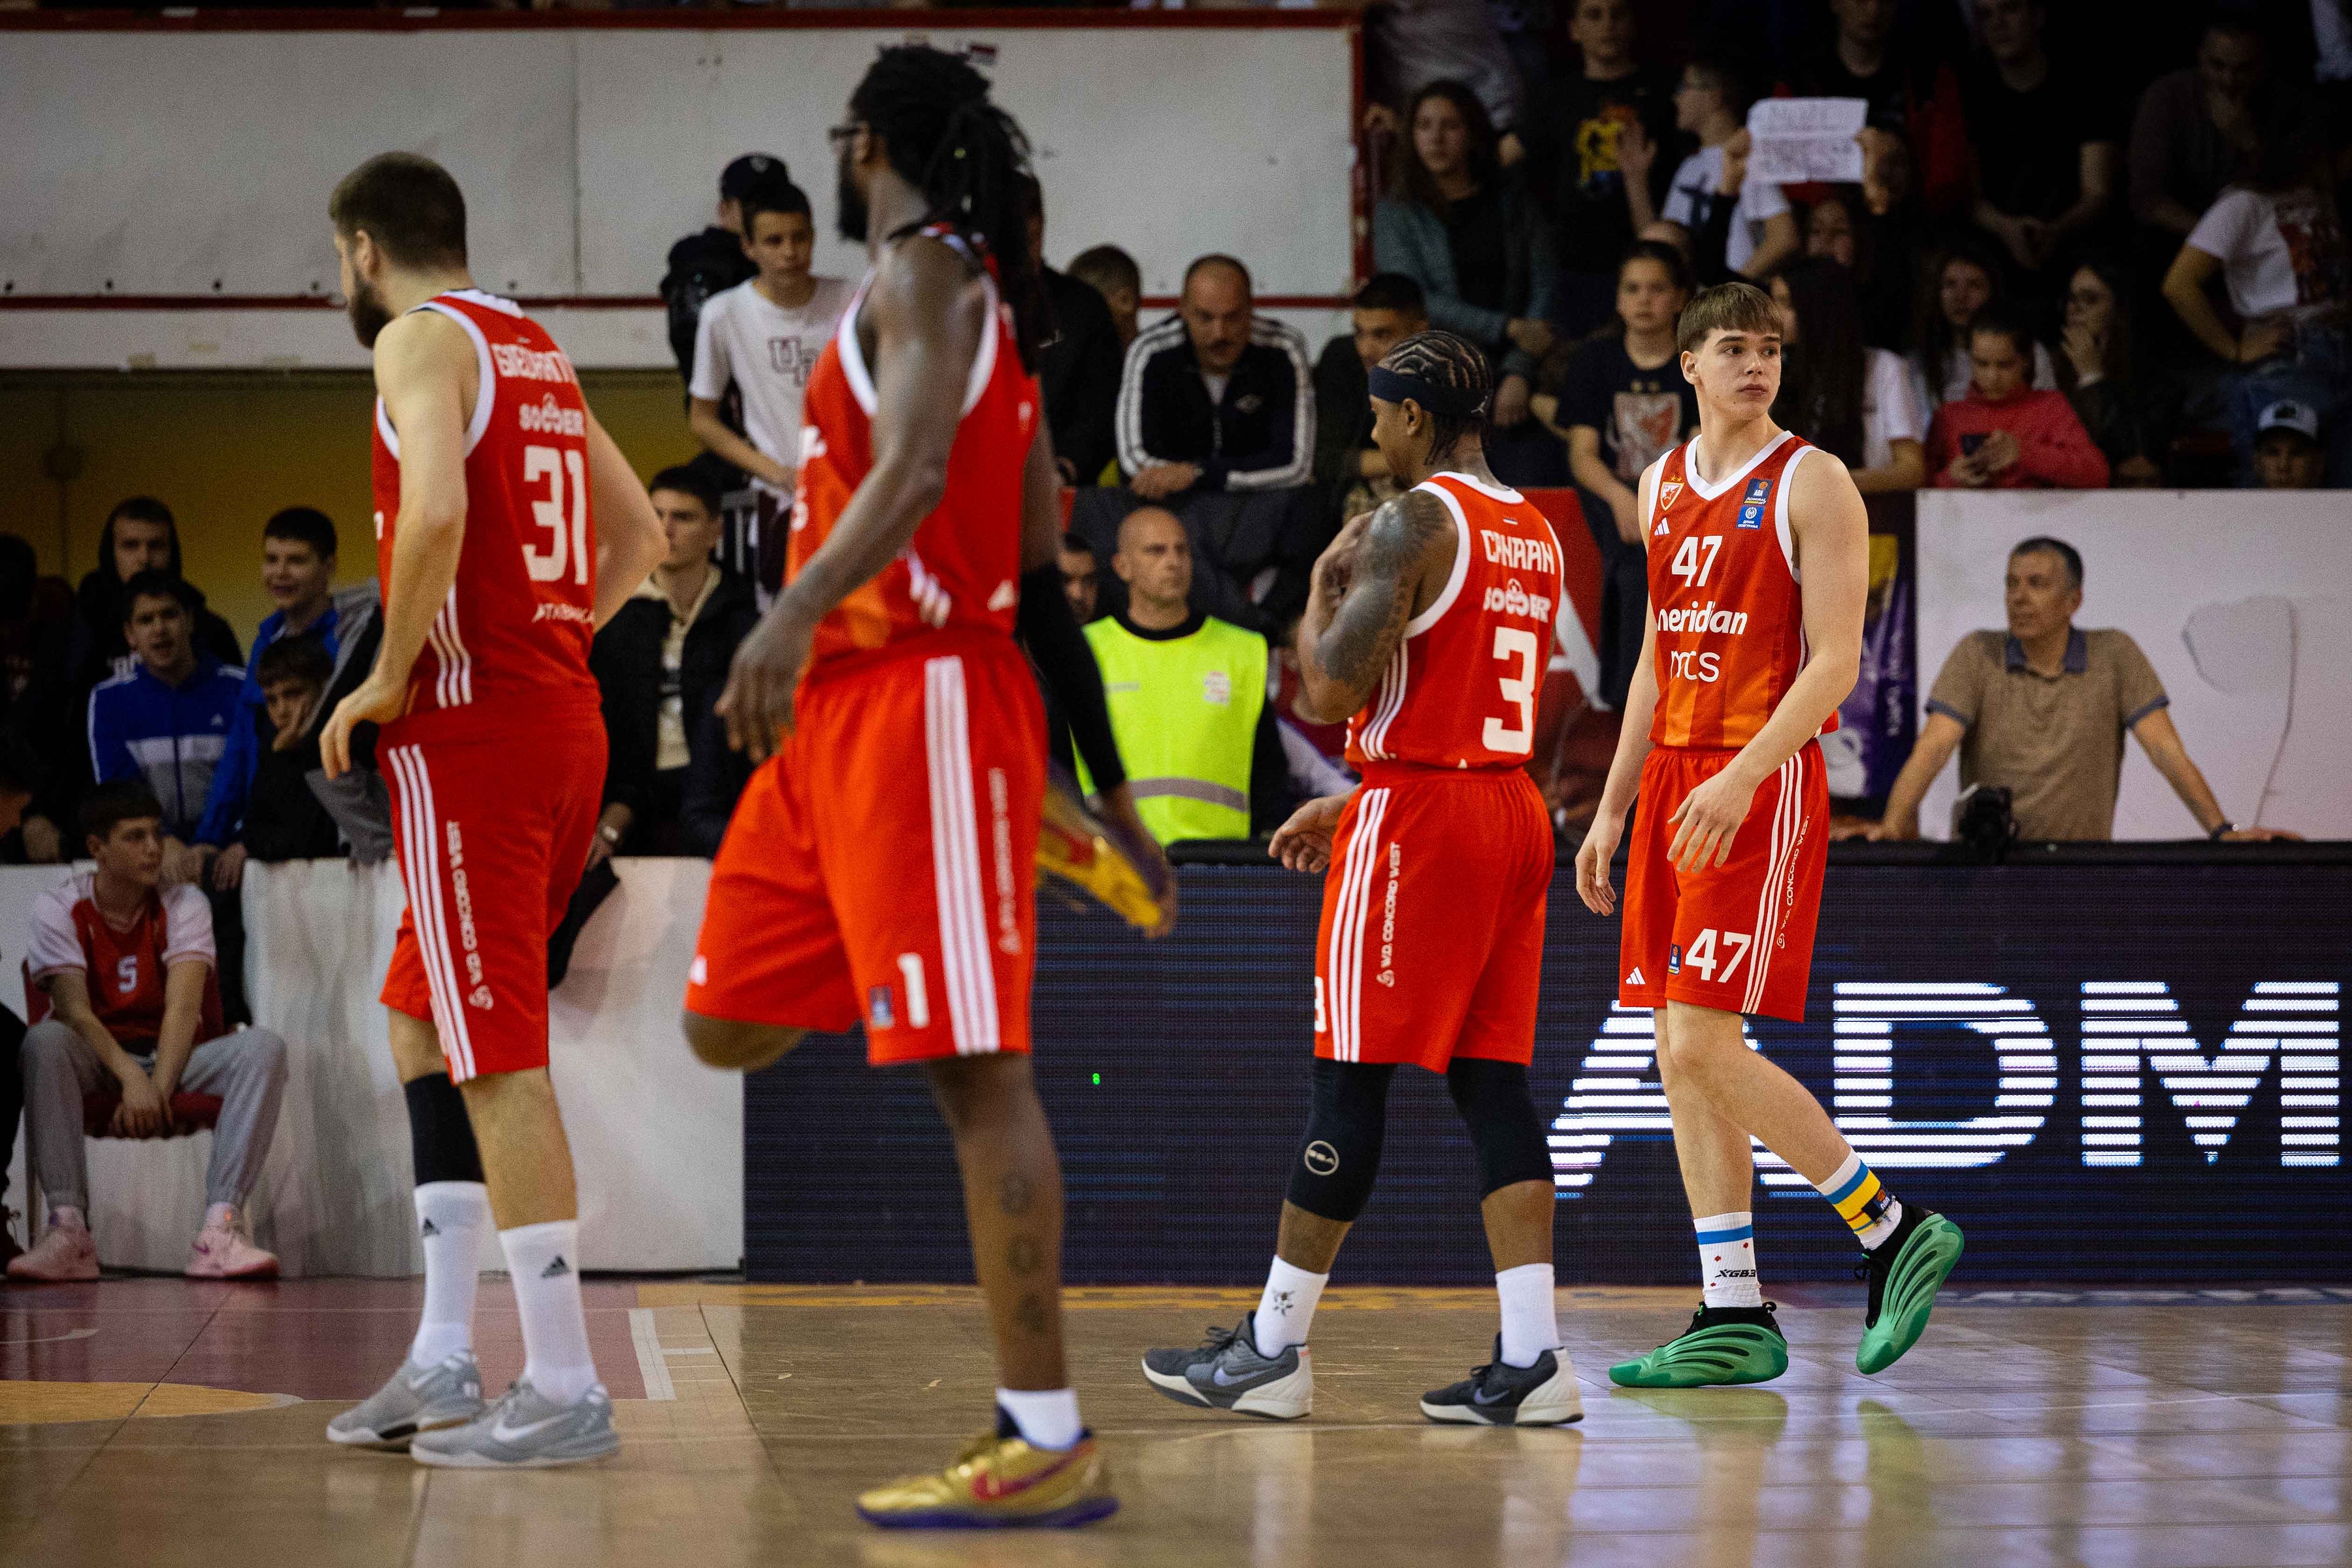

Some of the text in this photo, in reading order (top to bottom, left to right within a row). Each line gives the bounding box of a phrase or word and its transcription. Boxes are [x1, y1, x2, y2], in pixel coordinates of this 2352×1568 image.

[521, 445, 588, 585] 31
[1671, 535, 1723, 587] 47
[1482, 626, 1538, 755] 3
[1786, 848, 1799, 906] CONCORD
[118, 955, 137, 993] 5
[1685, 928, 1752, 983] 47
[896, 953, 930, 1028] 1
